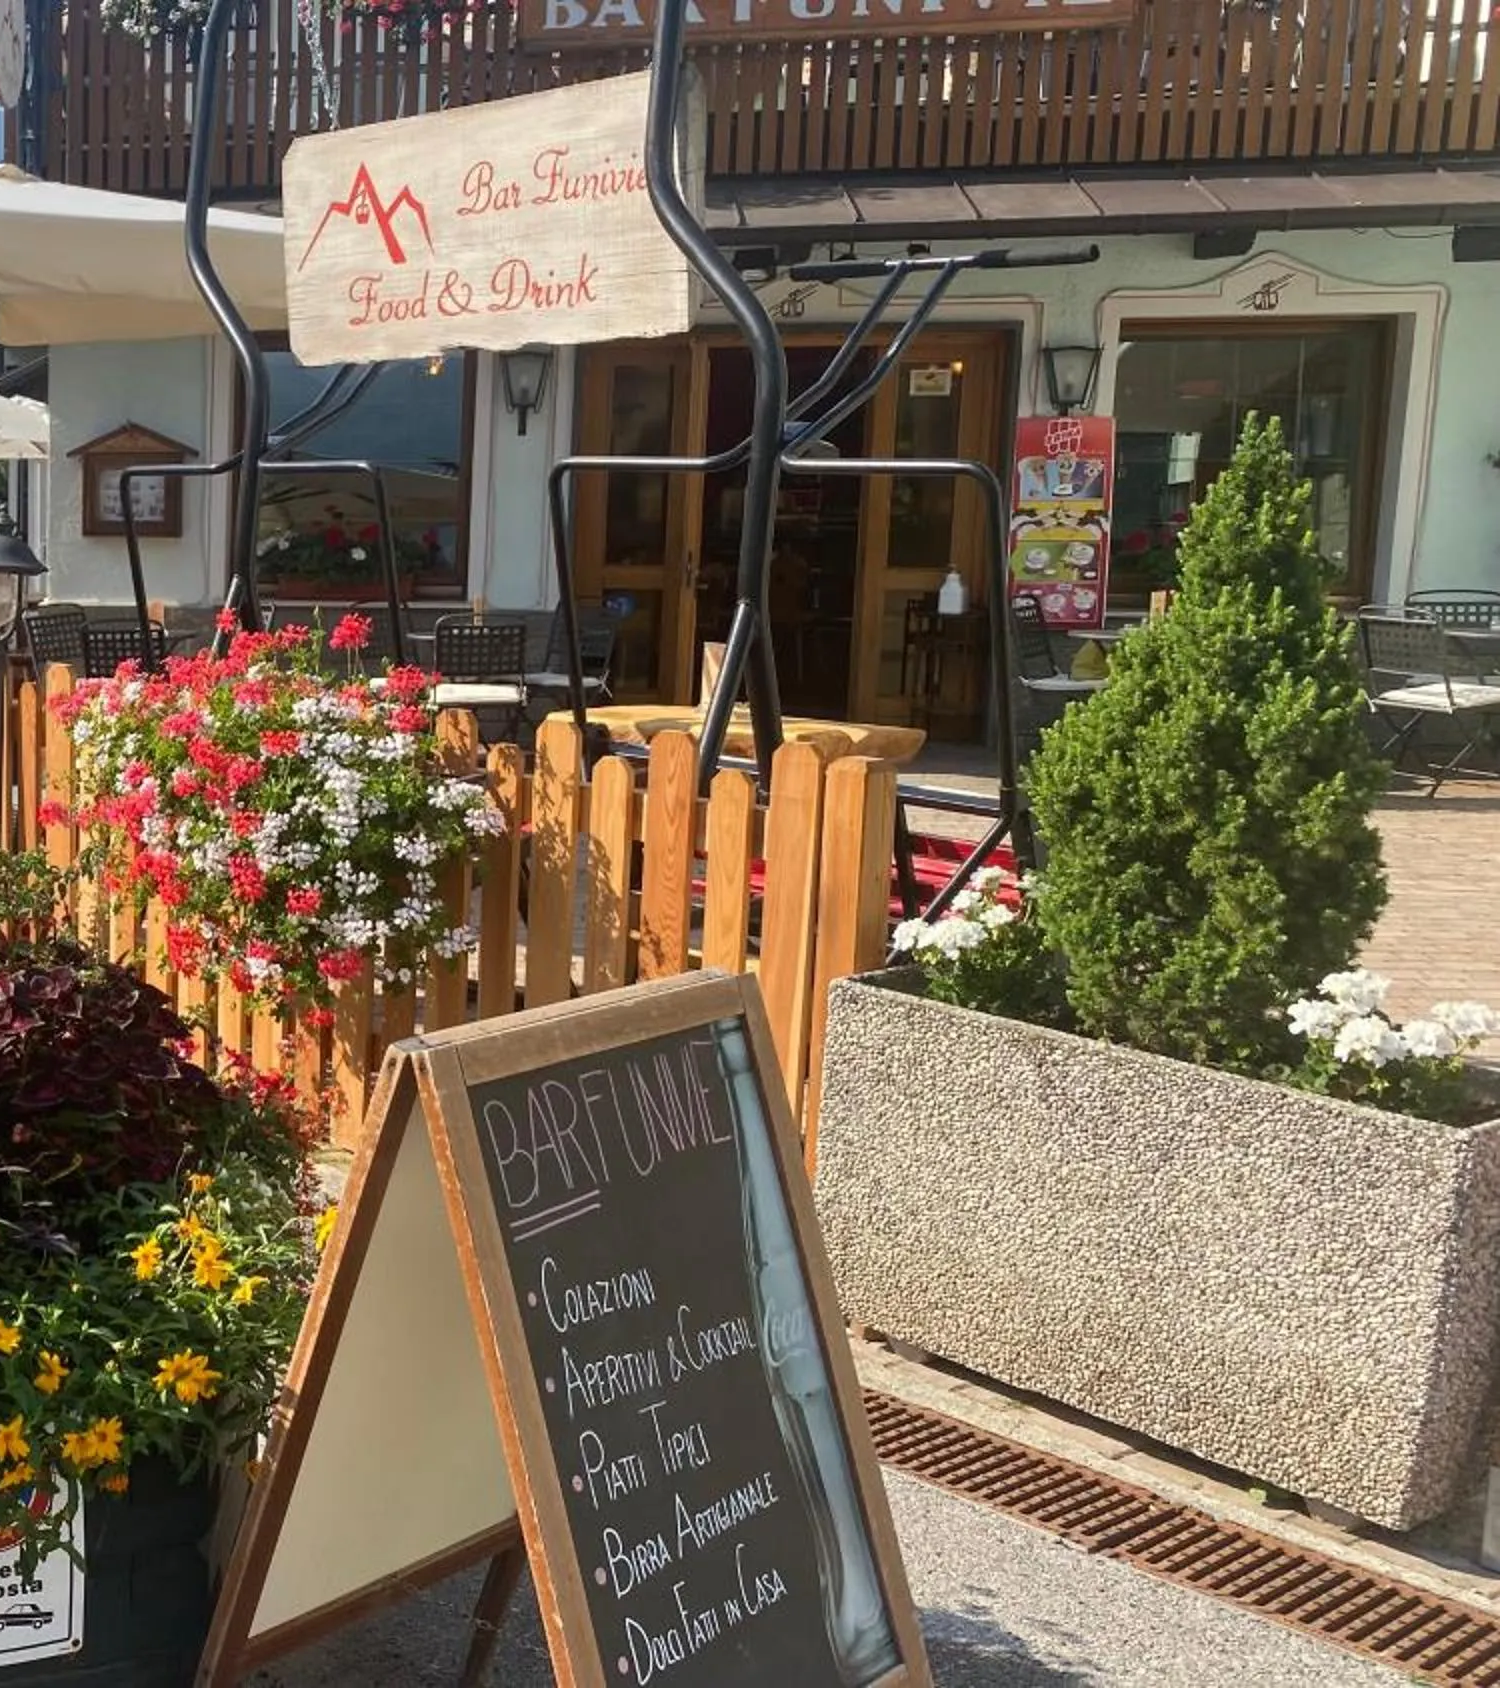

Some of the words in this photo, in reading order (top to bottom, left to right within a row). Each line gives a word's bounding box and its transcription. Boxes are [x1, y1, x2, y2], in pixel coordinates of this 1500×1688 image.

[456, 161, 521, 216] Bar
[531, 145, 647, 205] Funivie
[349, 272, 428, 326] Food
[437, 269, 479, 316] &
[487, 253, 598, 313] Drink
[541, 1257, 656, 1333] COLAZIONI
[667, 1335, 688, 1383] &
[677, 1304, 757, 1371] COCKTAIL
[561, 1346, 662, 1420] APERITIVI
[579, 1430, 648, 1511] PIATTI
[637, 1400, 712, 1476] TIPICI
[603, 1527, 673, 1600] BIRRA
[674, 1471, 779, 1560] ARTIGIANALE
[673, 1581, 721, 1654] FATTI
[723, 1599, 743, 1627] IN
[735, 1543, 788, 1616] CASA
